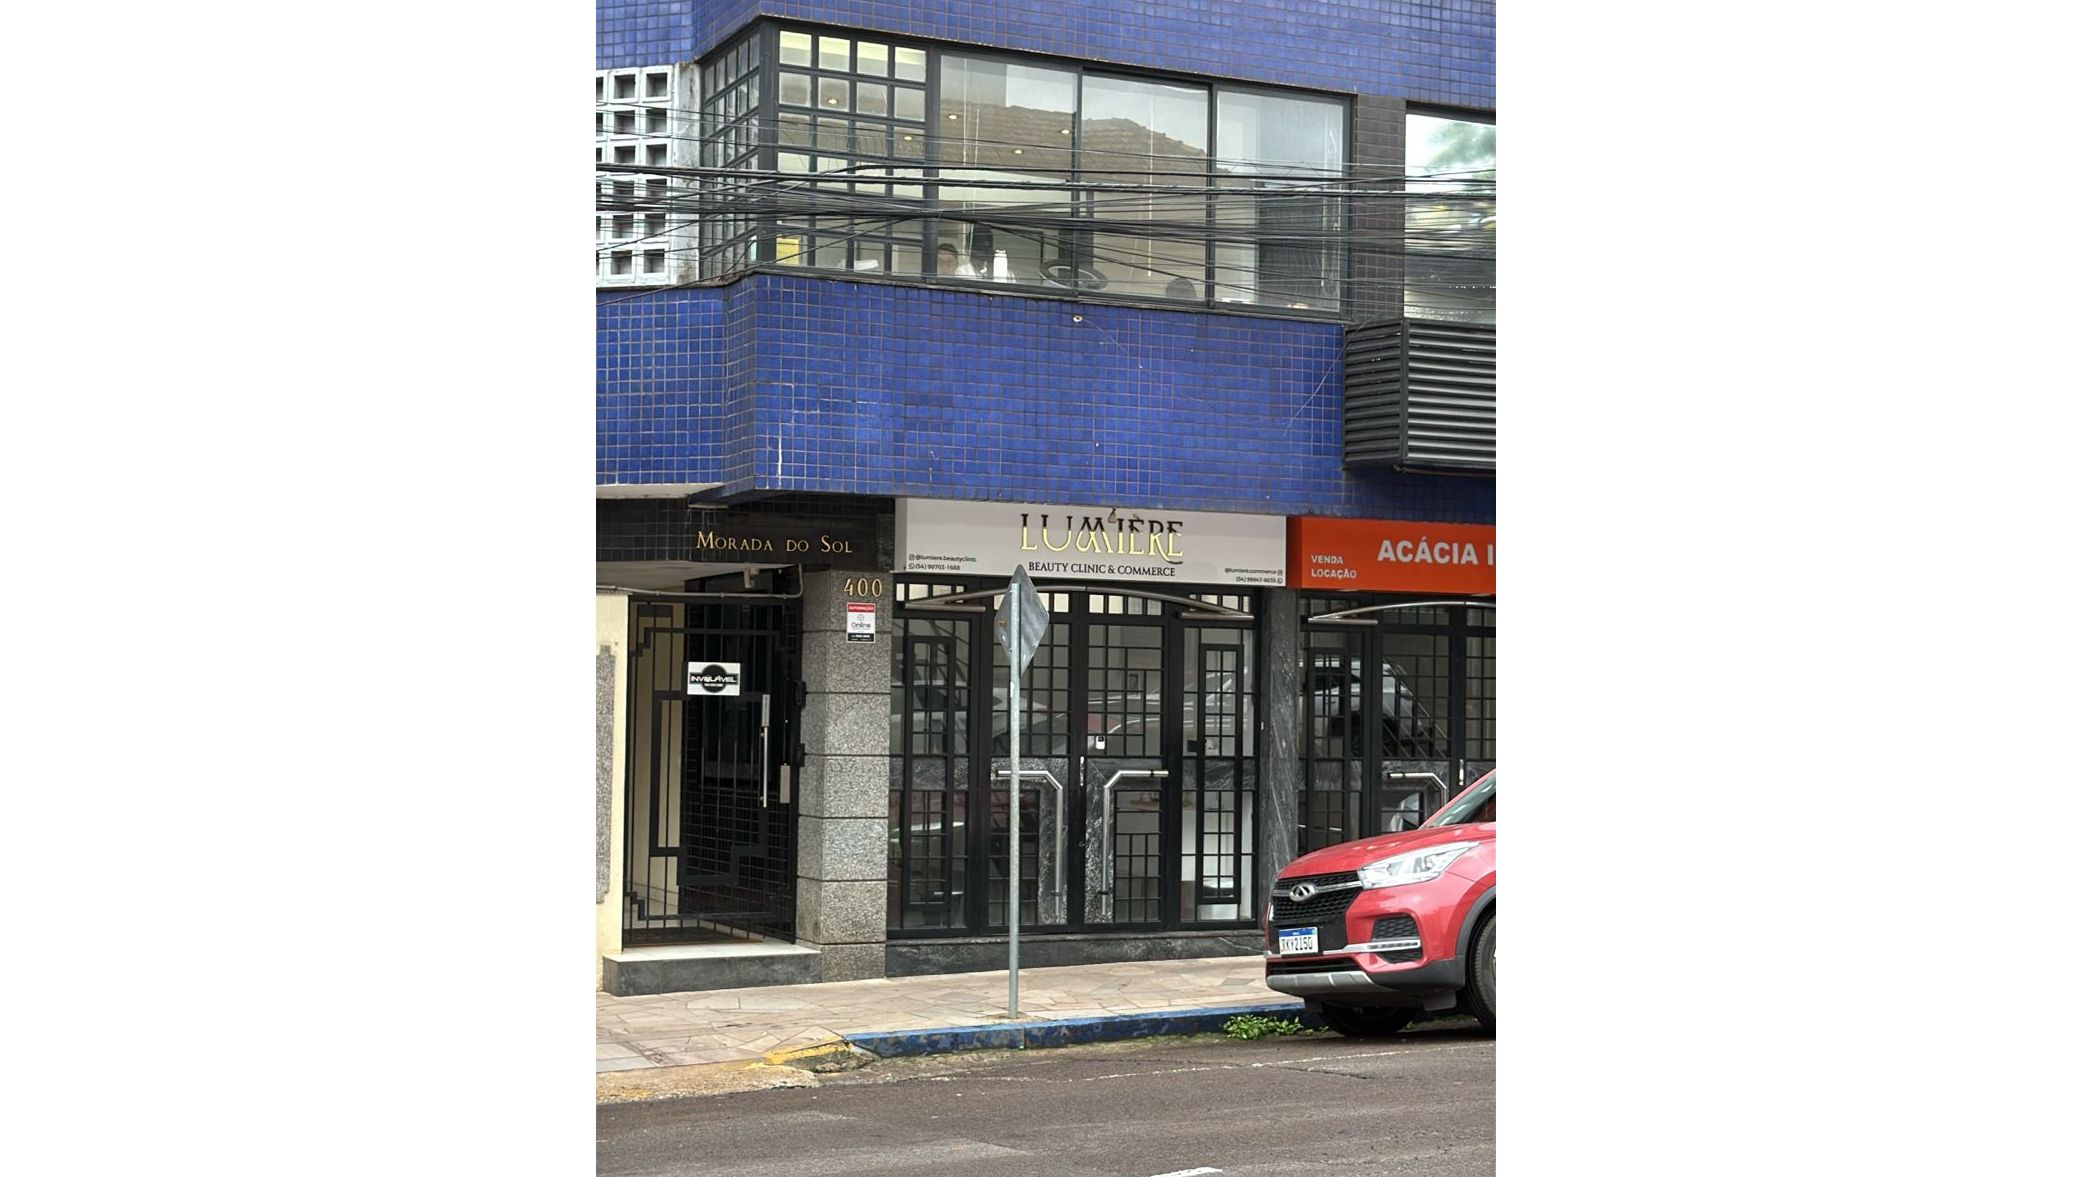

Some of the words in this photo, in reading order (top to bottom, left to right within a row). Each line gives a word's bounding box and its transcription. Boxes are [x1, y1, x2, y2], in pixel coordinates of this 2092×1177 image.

[1377, 536, 1480, 565] ACÁCIA
[1311, 555, 1344, 564] VENDA
[1028, 562, 1070, 572] BEAUTY
[1071, 563, 1106, 574] CLINIC
[1108, 566, 1115, 574] &
[1115, 566, 1176, 577] COMMERCE
[1311, 568, 1357, 579] LOCAÇÃO
[843, 578, 883, 597] 400
